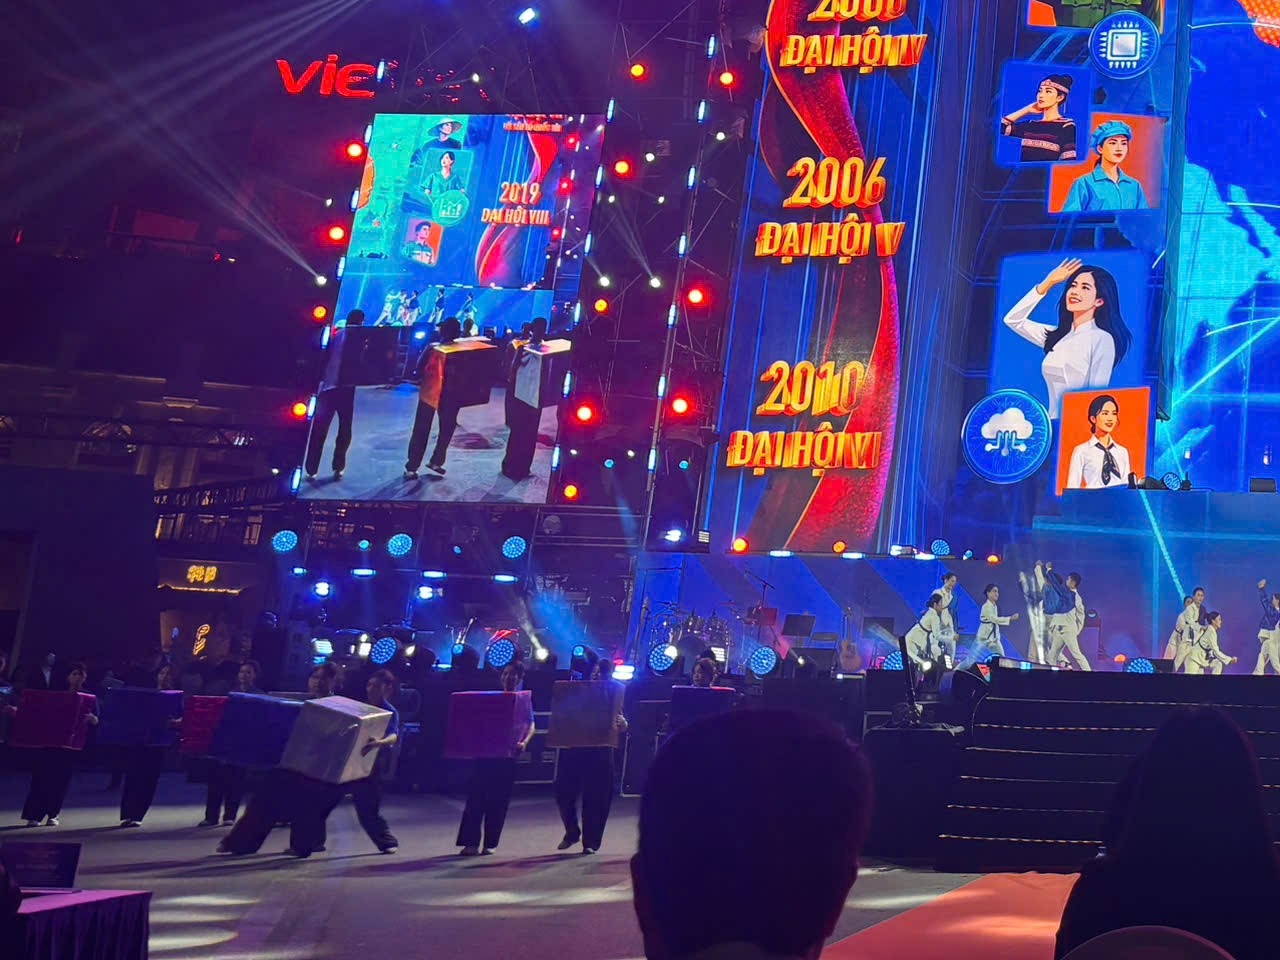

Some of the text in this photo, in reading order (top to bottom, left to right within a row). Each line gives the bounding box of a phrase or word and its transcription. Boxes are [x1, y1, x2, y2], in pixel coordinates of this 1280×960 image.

[780, 34, 835, 74] ĐẠI
[833, 26, 890, 74] HỘI
[499, 182, 541, 204] 2019
[783, 157, 886, 208] 2006
[755, 213, 905, 264] ĐẠI HỘI V
[756, 360, 864, 416] 2010
[726, 431, 785, 475] ĐẠI
[783, 422, 844, 476] HỘI
